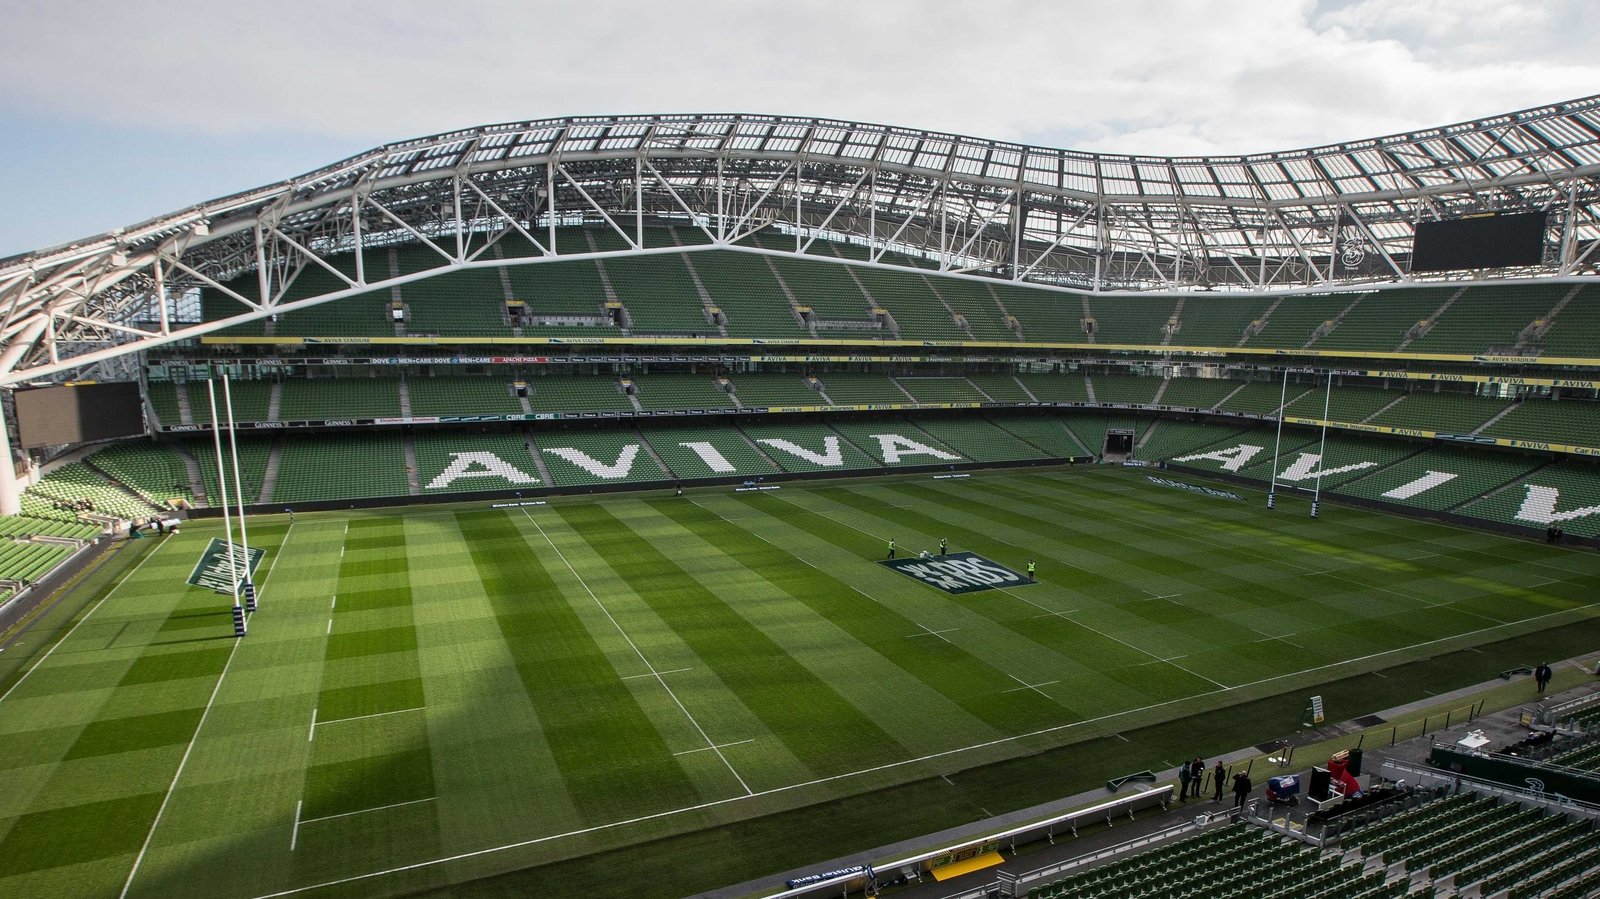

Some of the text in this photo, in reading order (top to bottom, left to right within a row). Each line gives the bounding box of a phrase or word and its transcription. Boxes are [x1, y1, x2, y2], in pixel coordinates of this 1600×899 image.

[1520, 441, 1549, 450] AVIVA
[425, 434, 962, 488] AVIVA
[926, 557, 1019, 586] RBS
